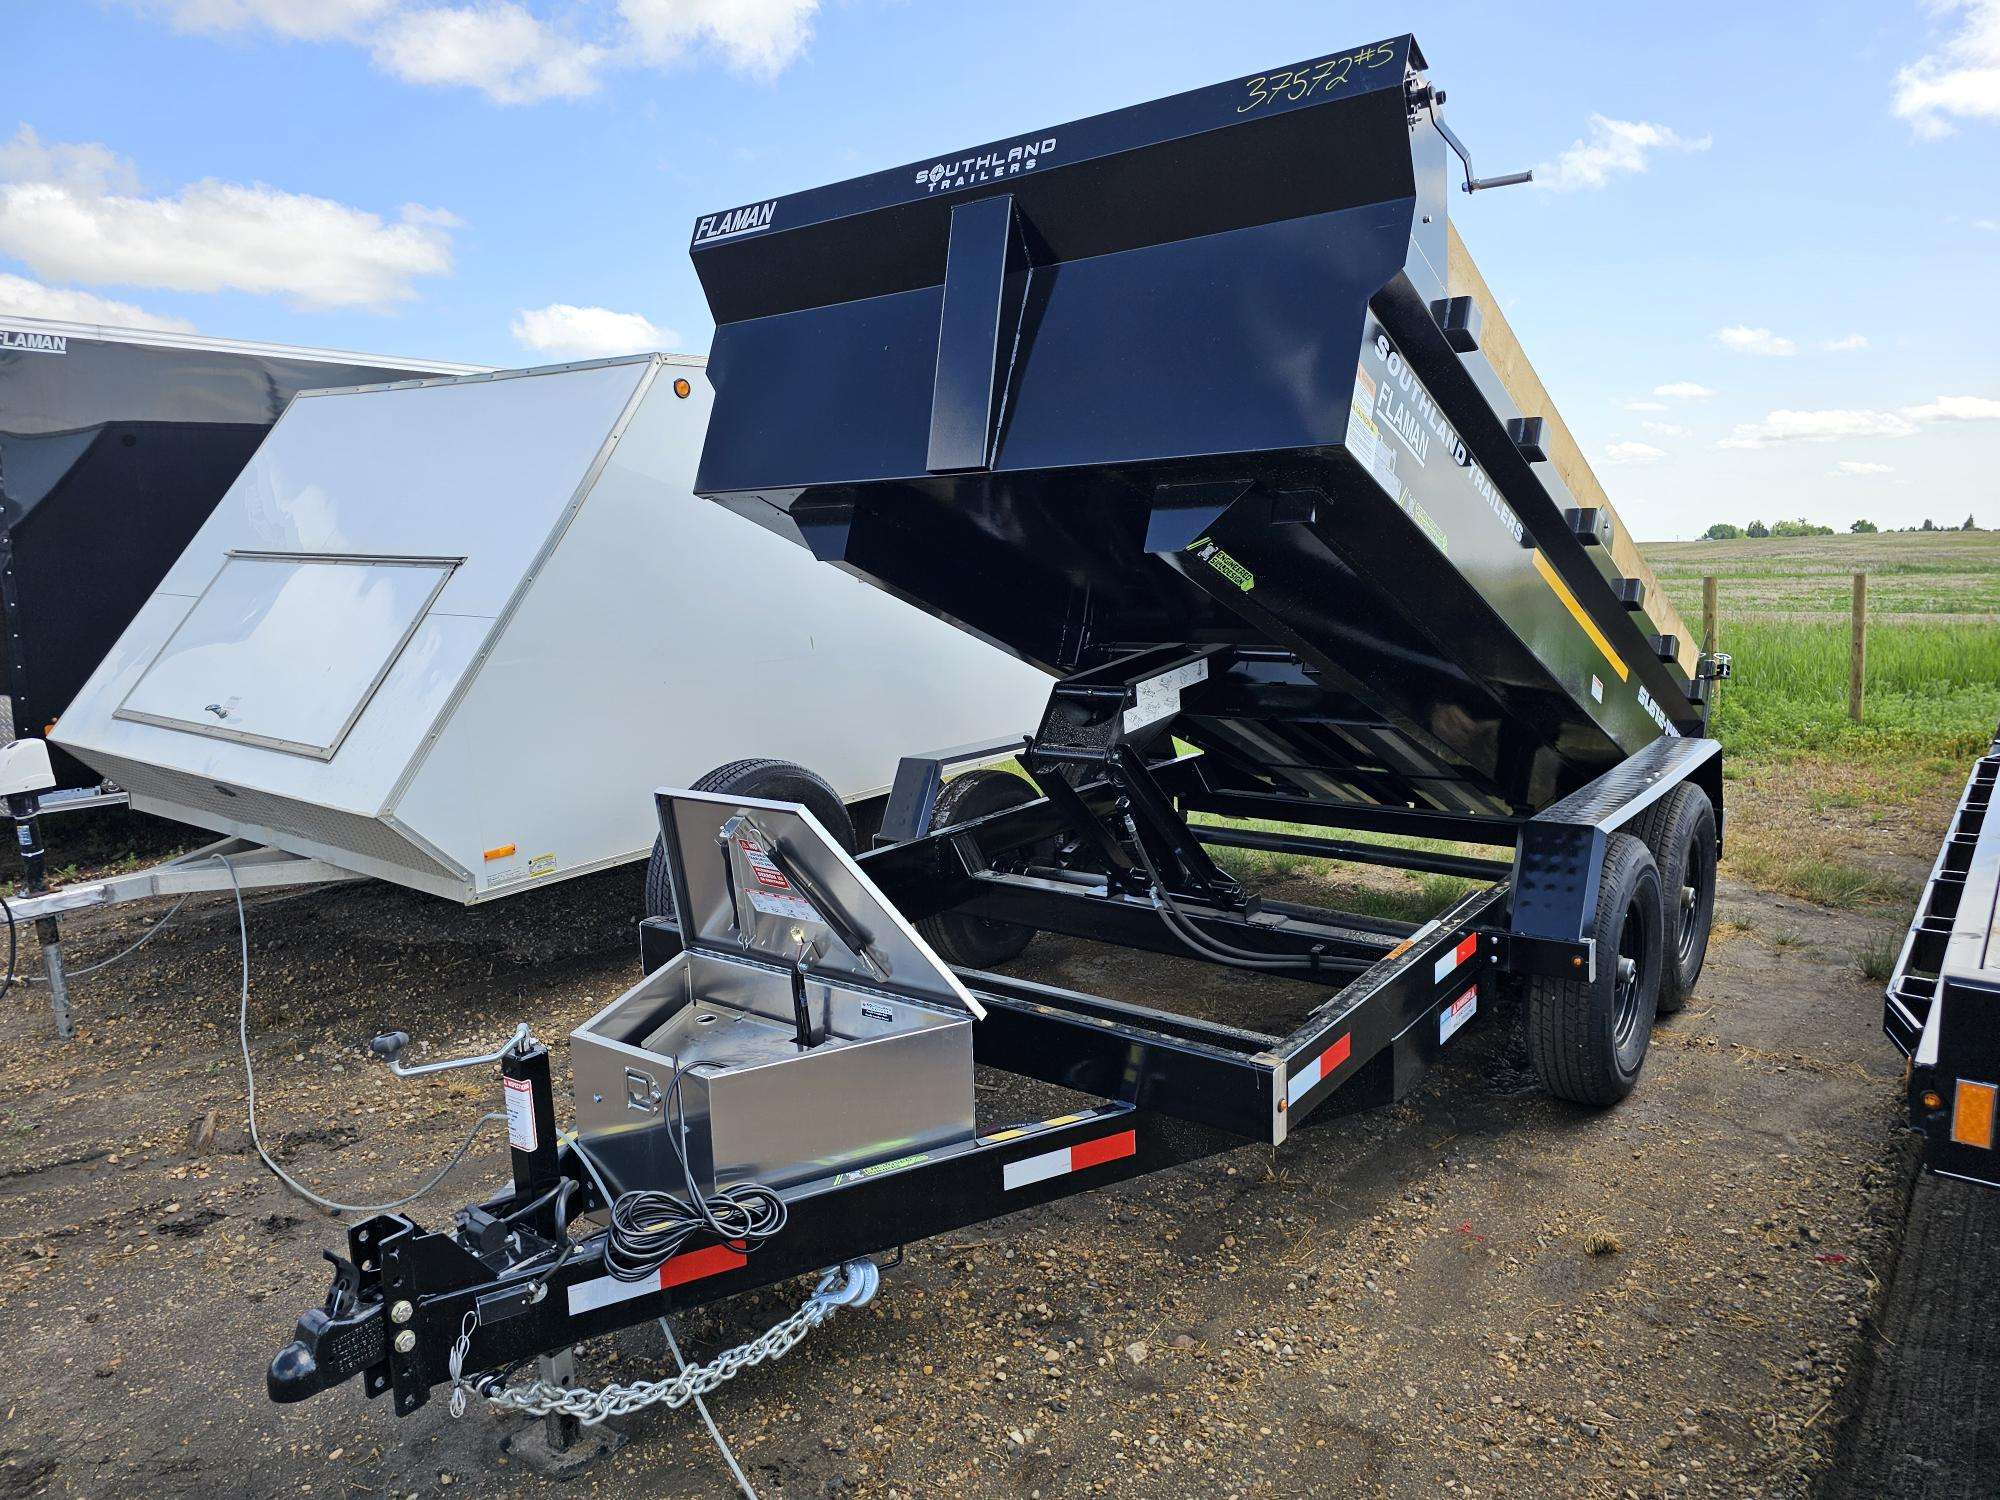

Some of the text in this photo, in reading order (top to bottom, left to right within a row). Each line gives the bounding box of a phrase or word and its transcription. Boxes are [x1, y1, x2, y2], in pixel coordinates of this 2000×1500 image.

[915, 138, 1057, 184] SOUTHLAND
[928, 158, 1037, 192] TRAILERS
[695, 201, 777, 240] FLAMAN
[1374, 335, 1467, 466] SOUTHLAND
[1469, 457, 1525, 543] TRAILERS
[1377, 380, 1430, 460] FLAMAN
[1215, 551, 1252, 581] ENGINEERED
